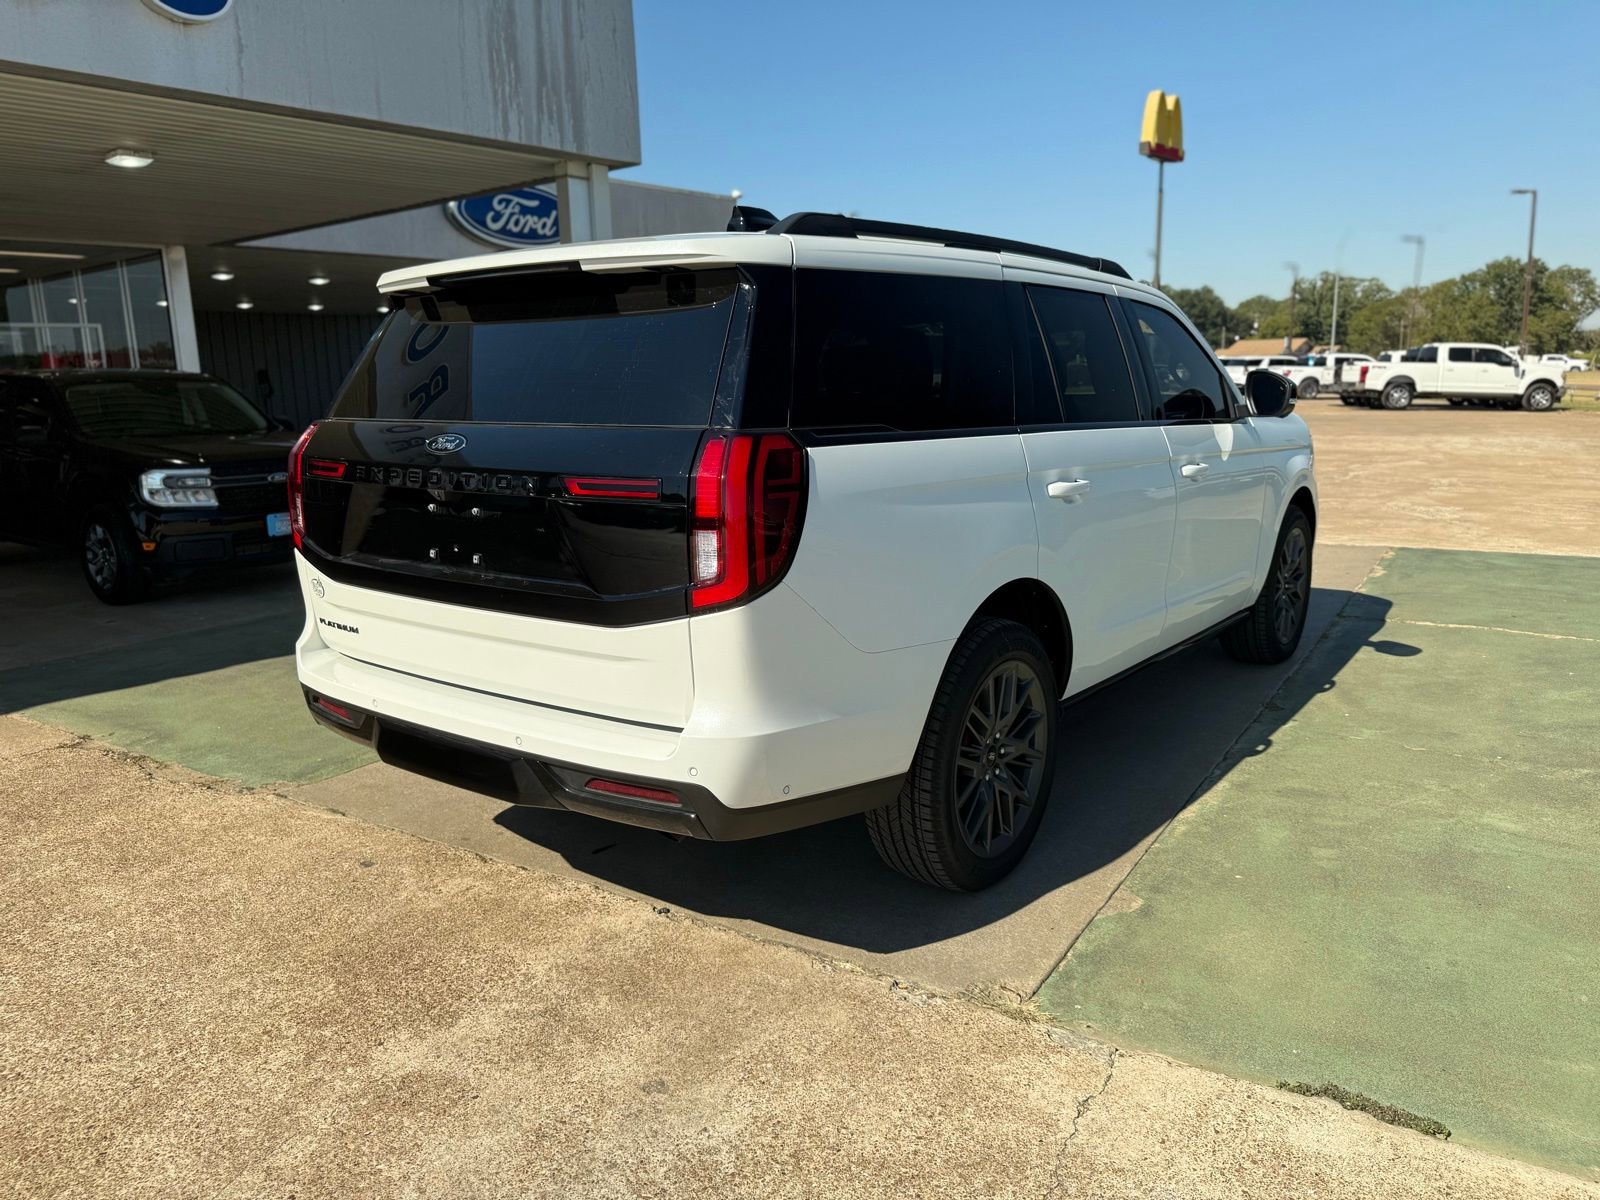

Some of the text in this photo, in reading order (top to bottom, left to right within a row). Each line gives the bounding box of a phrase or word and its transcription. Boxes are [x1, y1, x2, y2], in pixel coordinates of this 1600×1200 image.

[486, 194, 557, 236] Ford
[432, 436, 460, 450] Ford
[355, 465, 540, 496] EXPEDITION
[319, 617, 360, 635] PLATINUM
